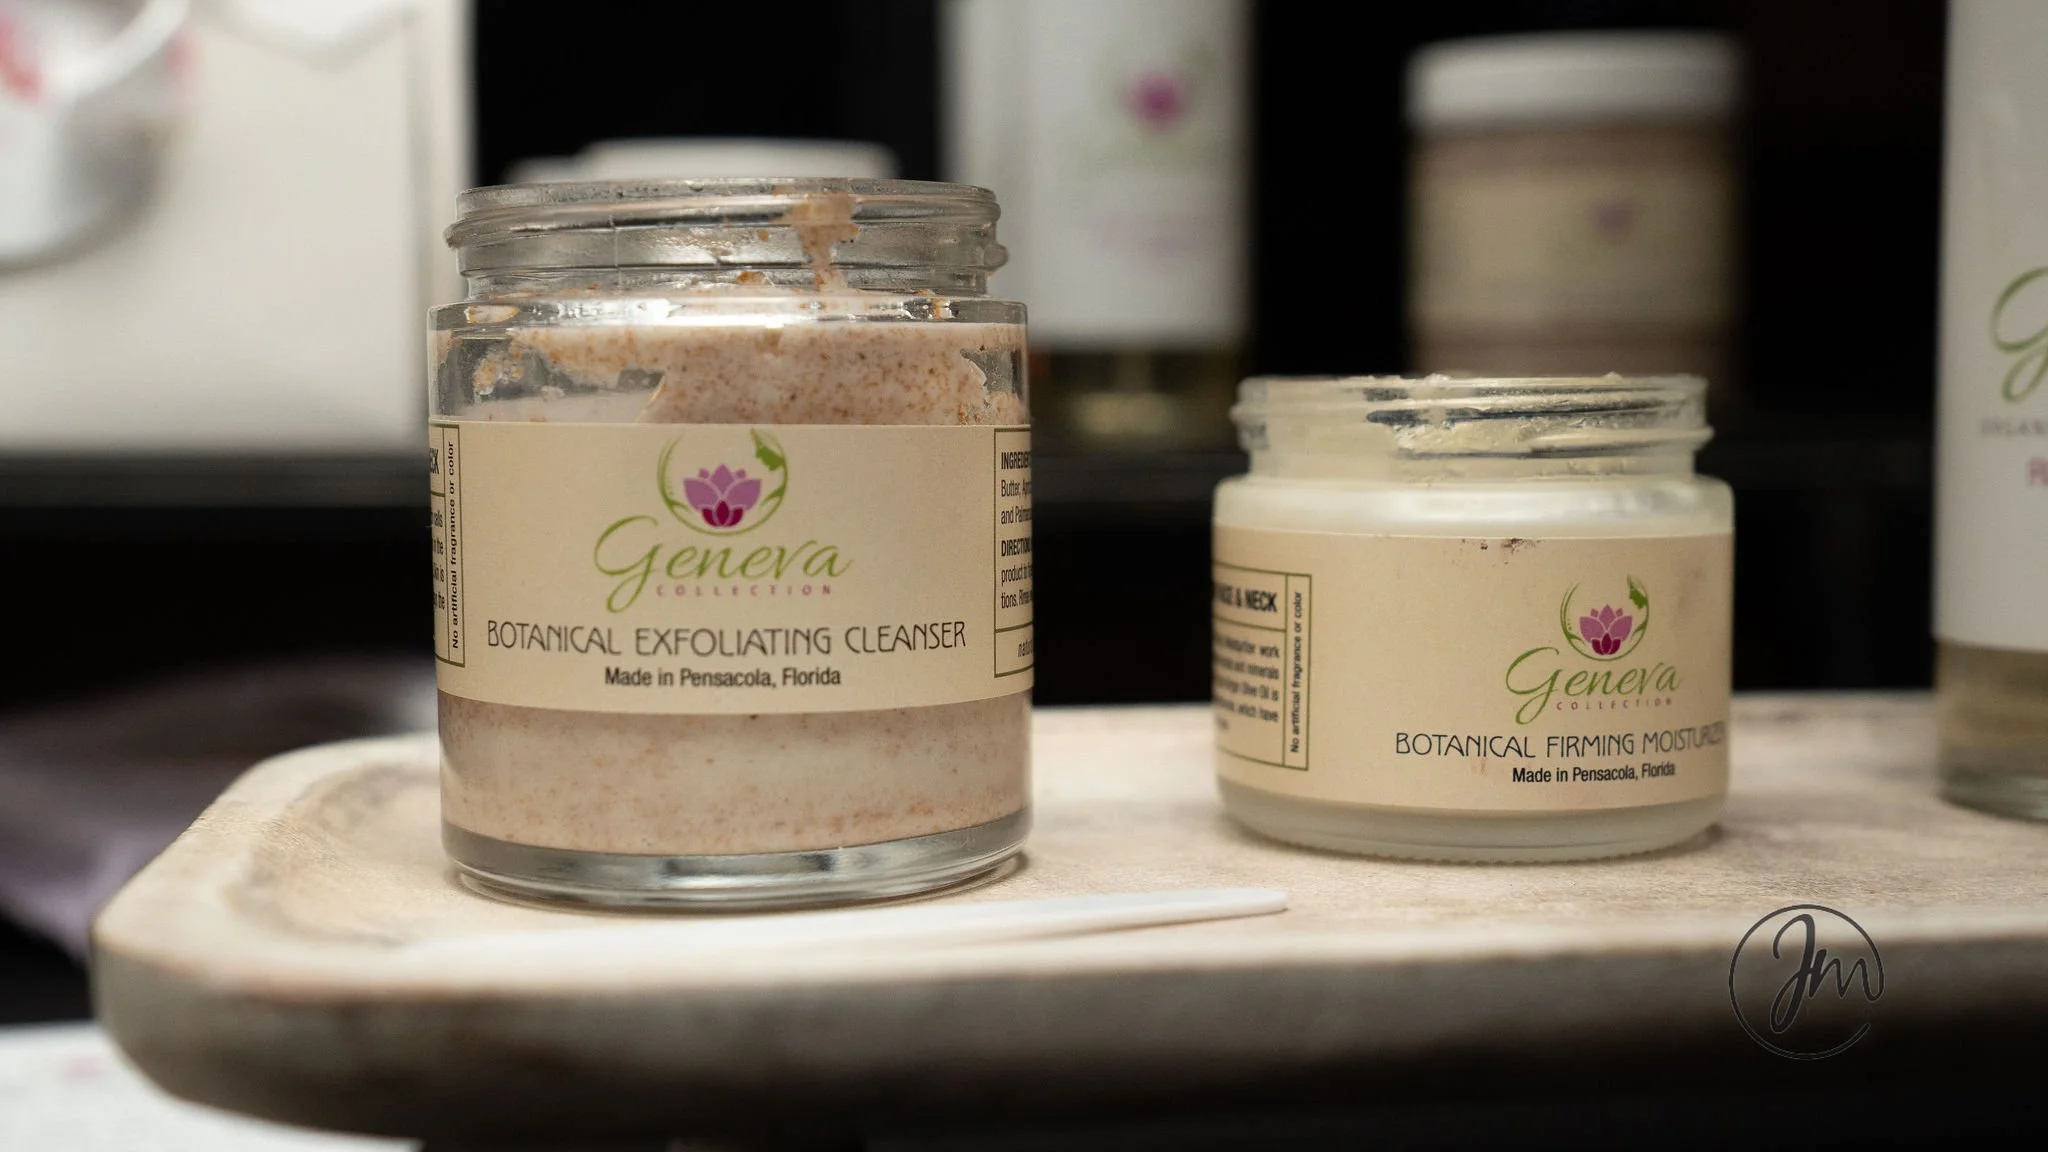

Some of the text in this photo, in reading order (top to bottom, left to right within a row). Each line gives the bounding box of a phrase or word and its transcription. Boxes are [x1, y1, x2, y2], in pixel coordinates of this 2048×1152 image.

[1001, 506, 1014, 524] and
[447, 441, 459, 648] No artificial fragrance or color
[594, 515, 853, 614] Geneva
[656, 584, 831, 598] COLLECTION
[1245, 589, 1278, 613] NECK
[487, 619, 966, 657] BOTANICAL EXFOLIATING CLEANSER
[605, 667, 841, 689] Made in Pensacola, Florida
[1290, 591, 1303, 753] No artificial fragrance or color
[1506, 646, 1684, 725] Geneva
[1556, 697, 1673, 711] COLLECTION
[1396, 732, 1536, 758] BOTANICAL
[1547, 733, 1634, 758] FIRMING
[1512, 761, 1675, 782] Made in Pensacola, Florida
